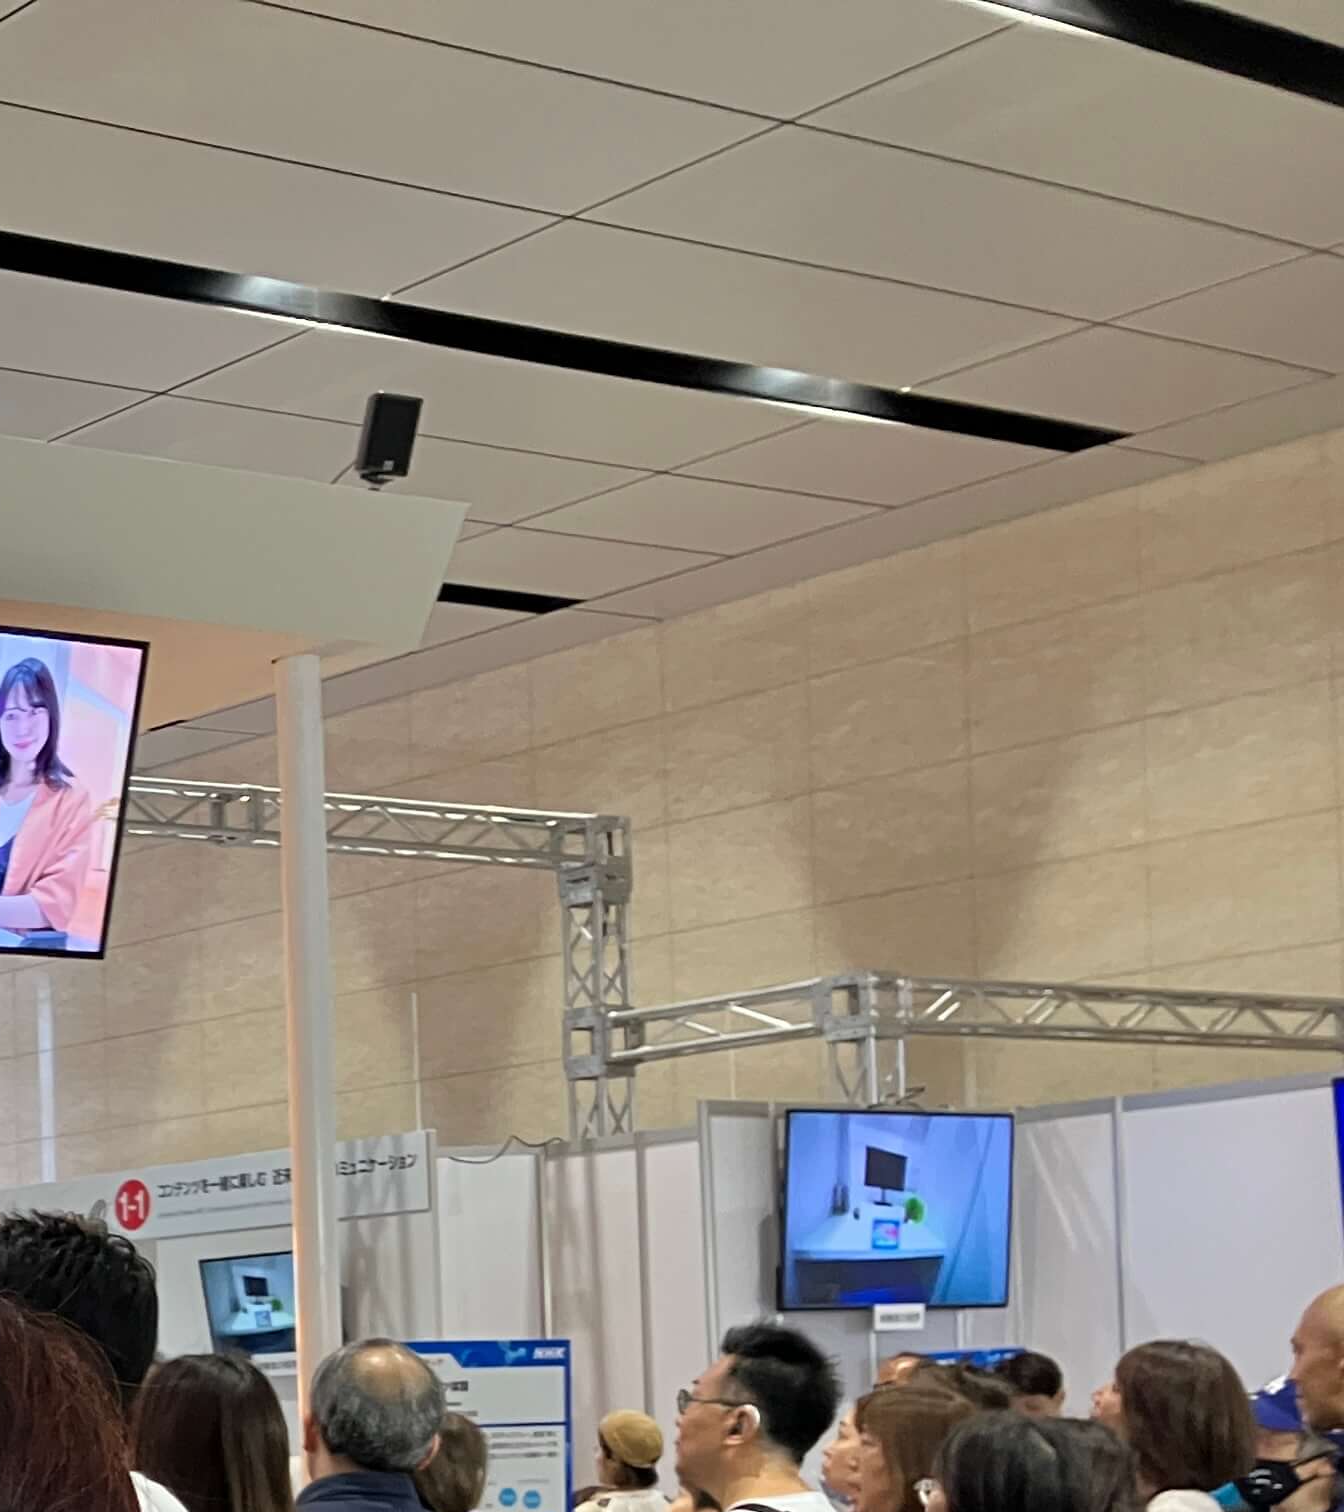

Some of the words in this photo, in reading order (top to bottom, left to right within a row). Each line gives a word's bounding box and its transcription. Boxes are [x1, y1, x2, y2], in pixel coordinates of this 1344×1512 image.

[336, 1153, 417, 1176] ミュニケーション
[118, 1189, 145, 1222] 1-1
